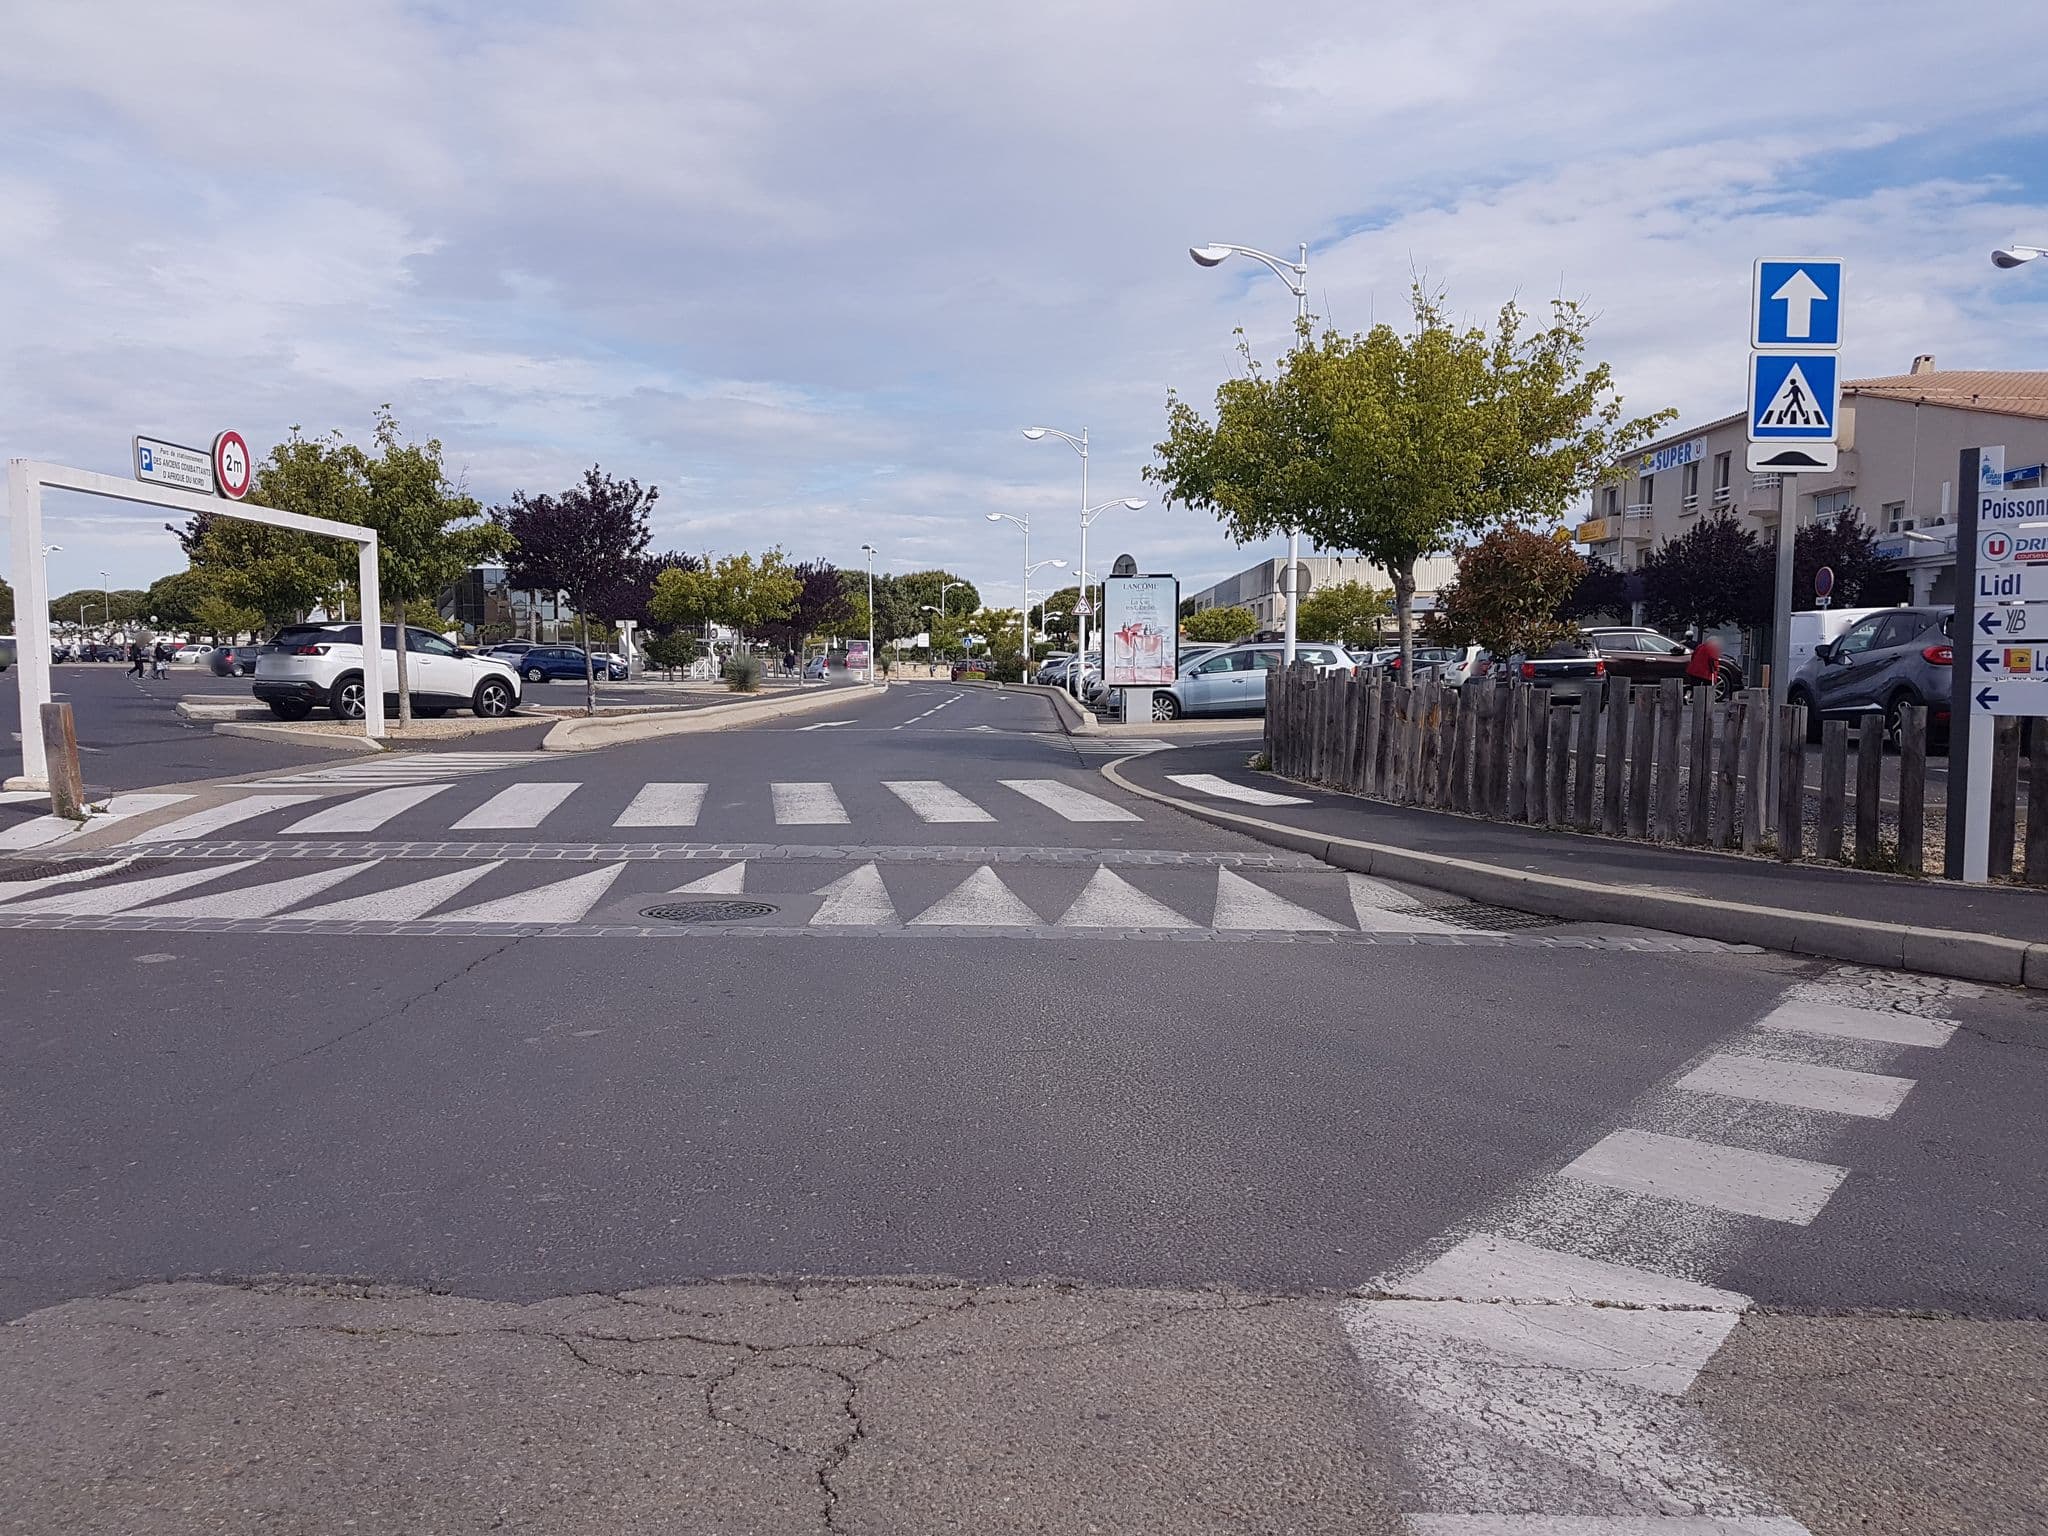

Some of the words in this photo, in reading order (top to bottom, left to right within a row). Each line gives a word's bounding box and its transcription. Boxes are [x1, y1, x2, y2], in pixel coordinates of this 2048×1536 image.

[1656, 442, 1691, 471] SUPER
[163, 459, 181, 470] ANCIENS
[181, 462, 211, 476] COMBATTANTS
[186, 475, 192, 484] DU
[193, 477, 205, 486] NORD
[1982, 497, 2048, 520] Poisson
[2016, 538, 2048, 551] DRI
[1980, 573, 2021, 596] Lidl
